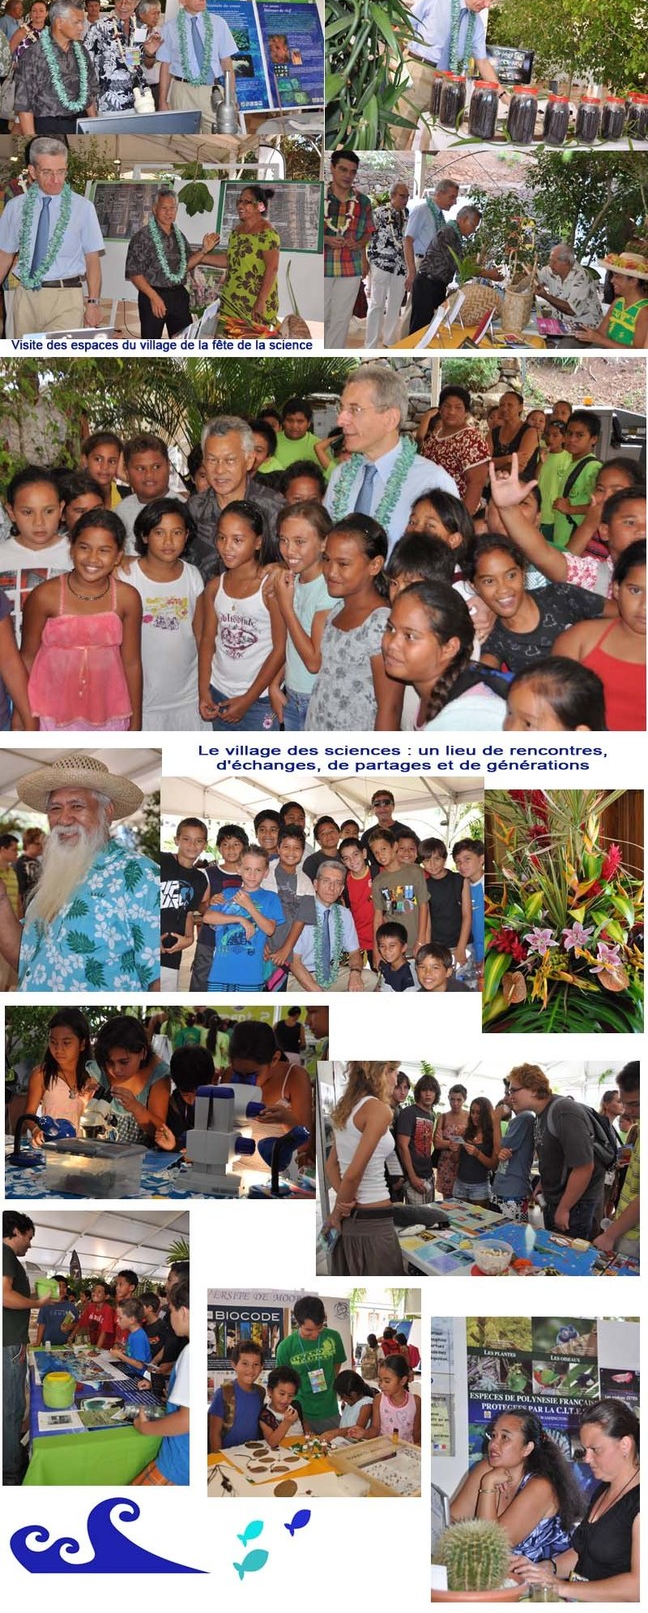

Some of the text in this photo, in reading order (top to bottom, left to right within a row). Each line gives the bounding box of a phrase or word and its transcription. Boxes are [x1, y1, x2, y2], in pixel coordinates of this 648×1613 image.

[215, 1311, 280, 1322] BIOCODE
[505, 1394, 516, 1402] DE
[528, 1405, 543, 1413] PAR
